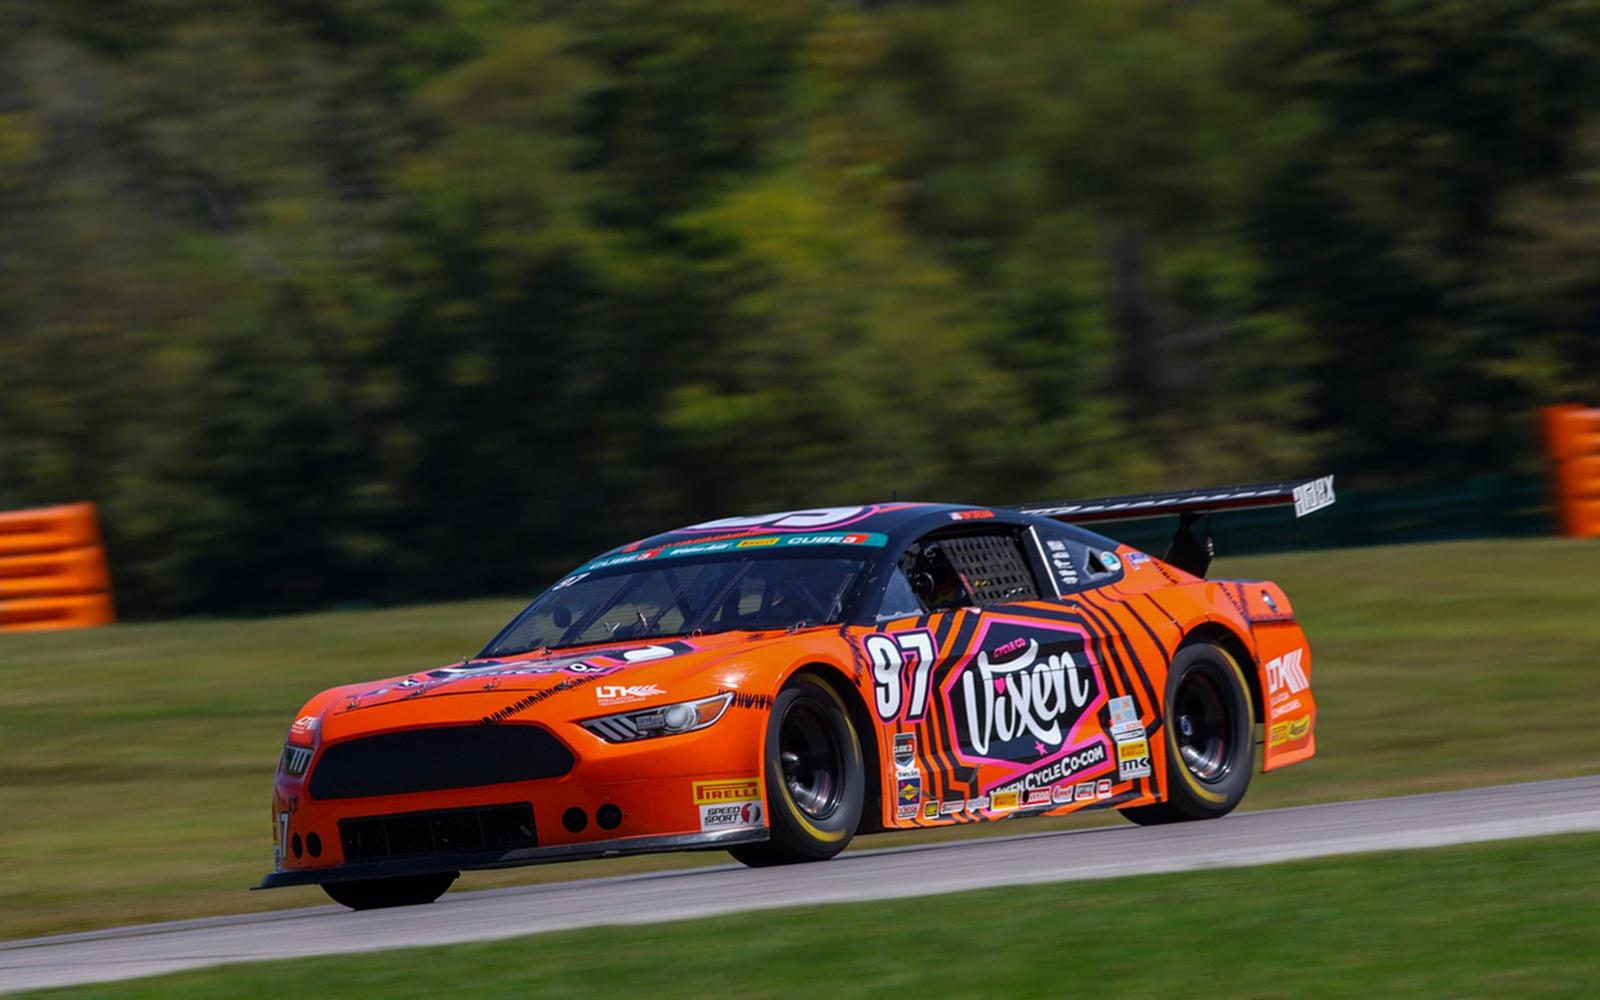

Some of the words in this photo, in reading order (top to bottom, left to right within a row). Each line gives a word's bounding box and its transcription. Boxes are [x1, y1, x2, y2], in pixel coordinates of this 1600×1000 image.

[866, 631, 936, 720] 97
[962, 638, 1090, 755] Vixen
[697, 782, 758, 800] PIRELLI
[704, 814, 739, 824] SPORT
[707, 806, 741, 816] SPEED
